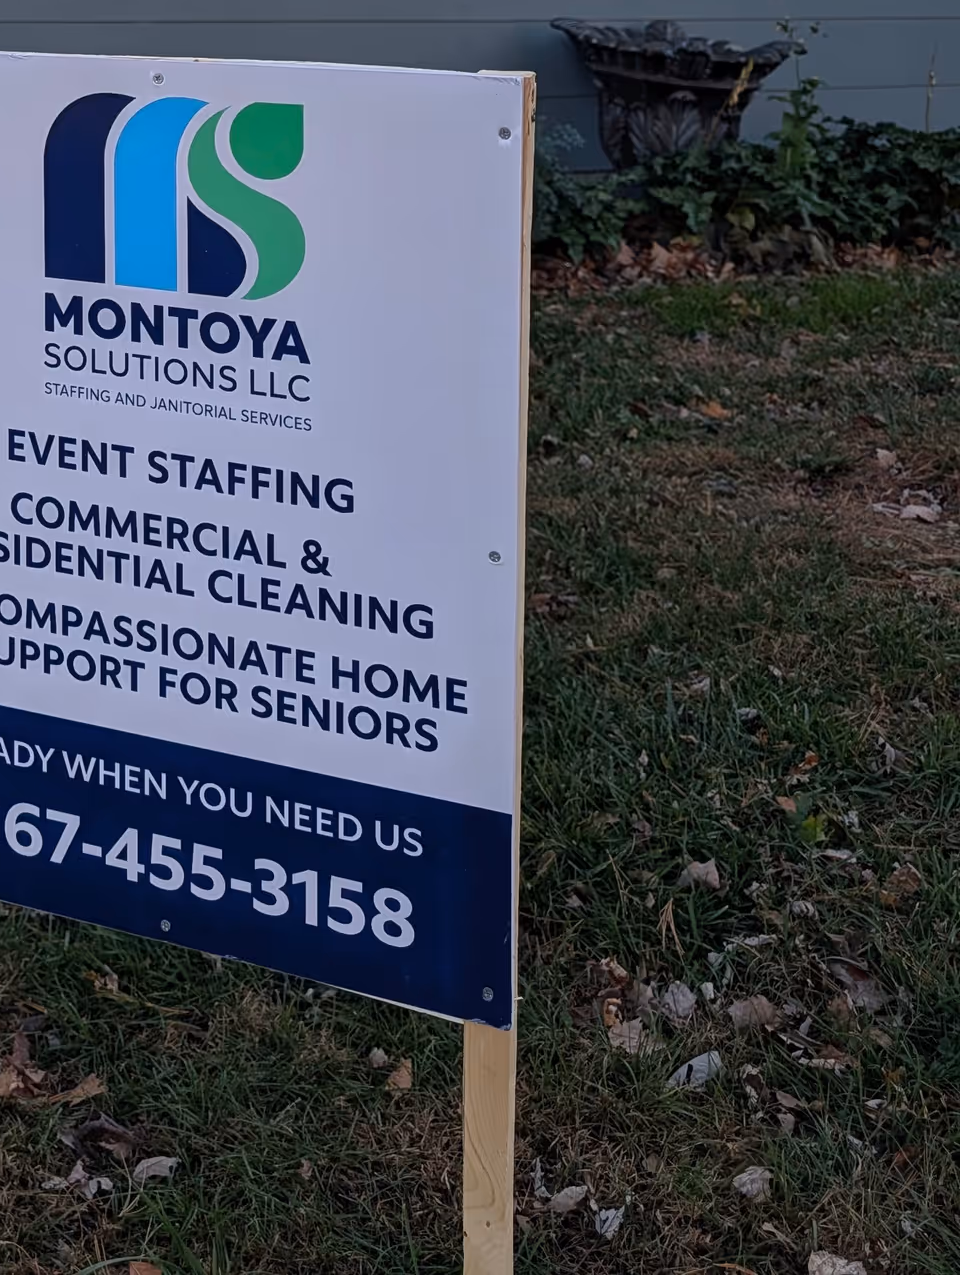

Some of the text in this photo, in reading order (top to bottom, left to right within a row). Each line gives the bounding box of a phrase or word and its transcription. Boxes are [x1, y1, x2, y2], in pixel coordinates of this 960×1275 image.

[44, 292, 310, 365] MONTOYA
[43, 342, 311, 403] SOLUTIONS LLC
[44, 381, 312, 432] STAFFING AND JANITORIAL SERVICES
[7, 428, 355, 514] EVENT STAFFING
[10, 491, 333, 578] COMMERCIAL &
[207, 569, 435, 640] CLEANING
[159, 665, 239, 714] FOR
[251, 685, 439, 753] SENIORS
[331, 655, 468, 715] HOME
[61, 749, 167, 800] WHEN
[177, 775, 253, 818] YOU
[265, 795, 363, 842] NEED
[374, 820, 424, 857] US
